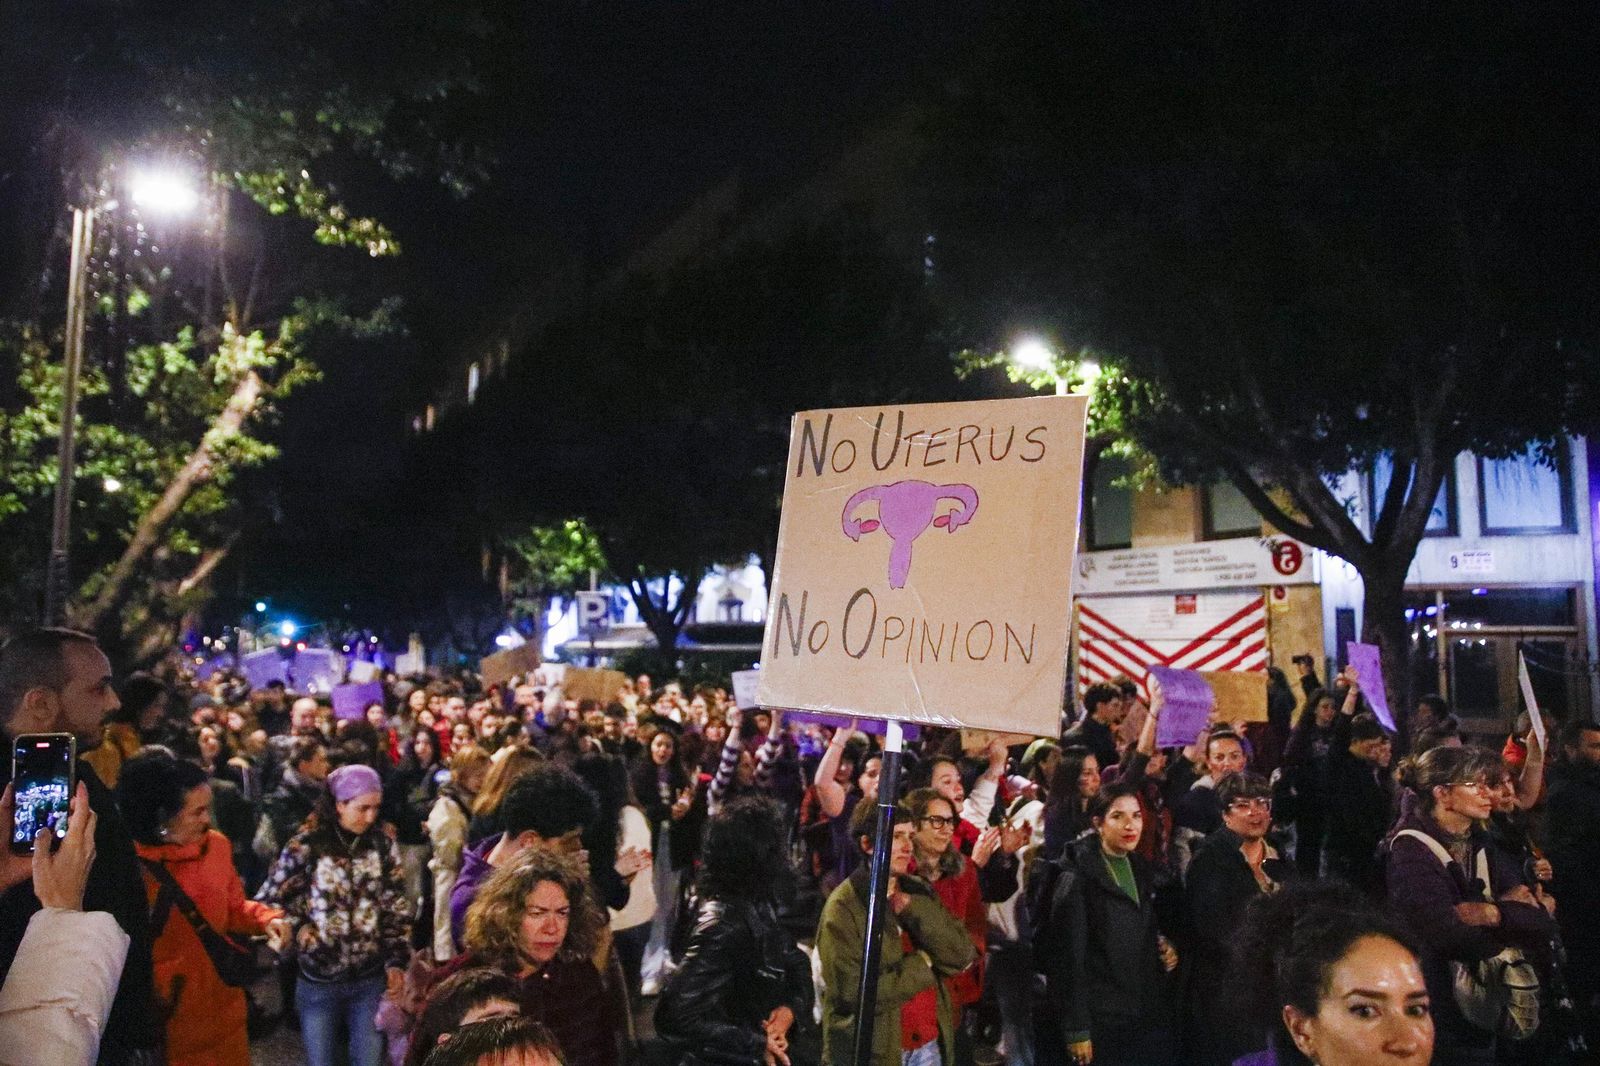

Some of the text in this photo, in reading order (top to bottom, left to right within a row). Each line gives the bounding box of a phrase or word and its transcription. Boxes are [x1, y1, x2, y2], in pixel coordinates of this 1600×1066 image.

[872, 411, 1047, 471] UTERUS
[578, 595, 607, 627] P
[843, 587, 1036, 664] OPINION
